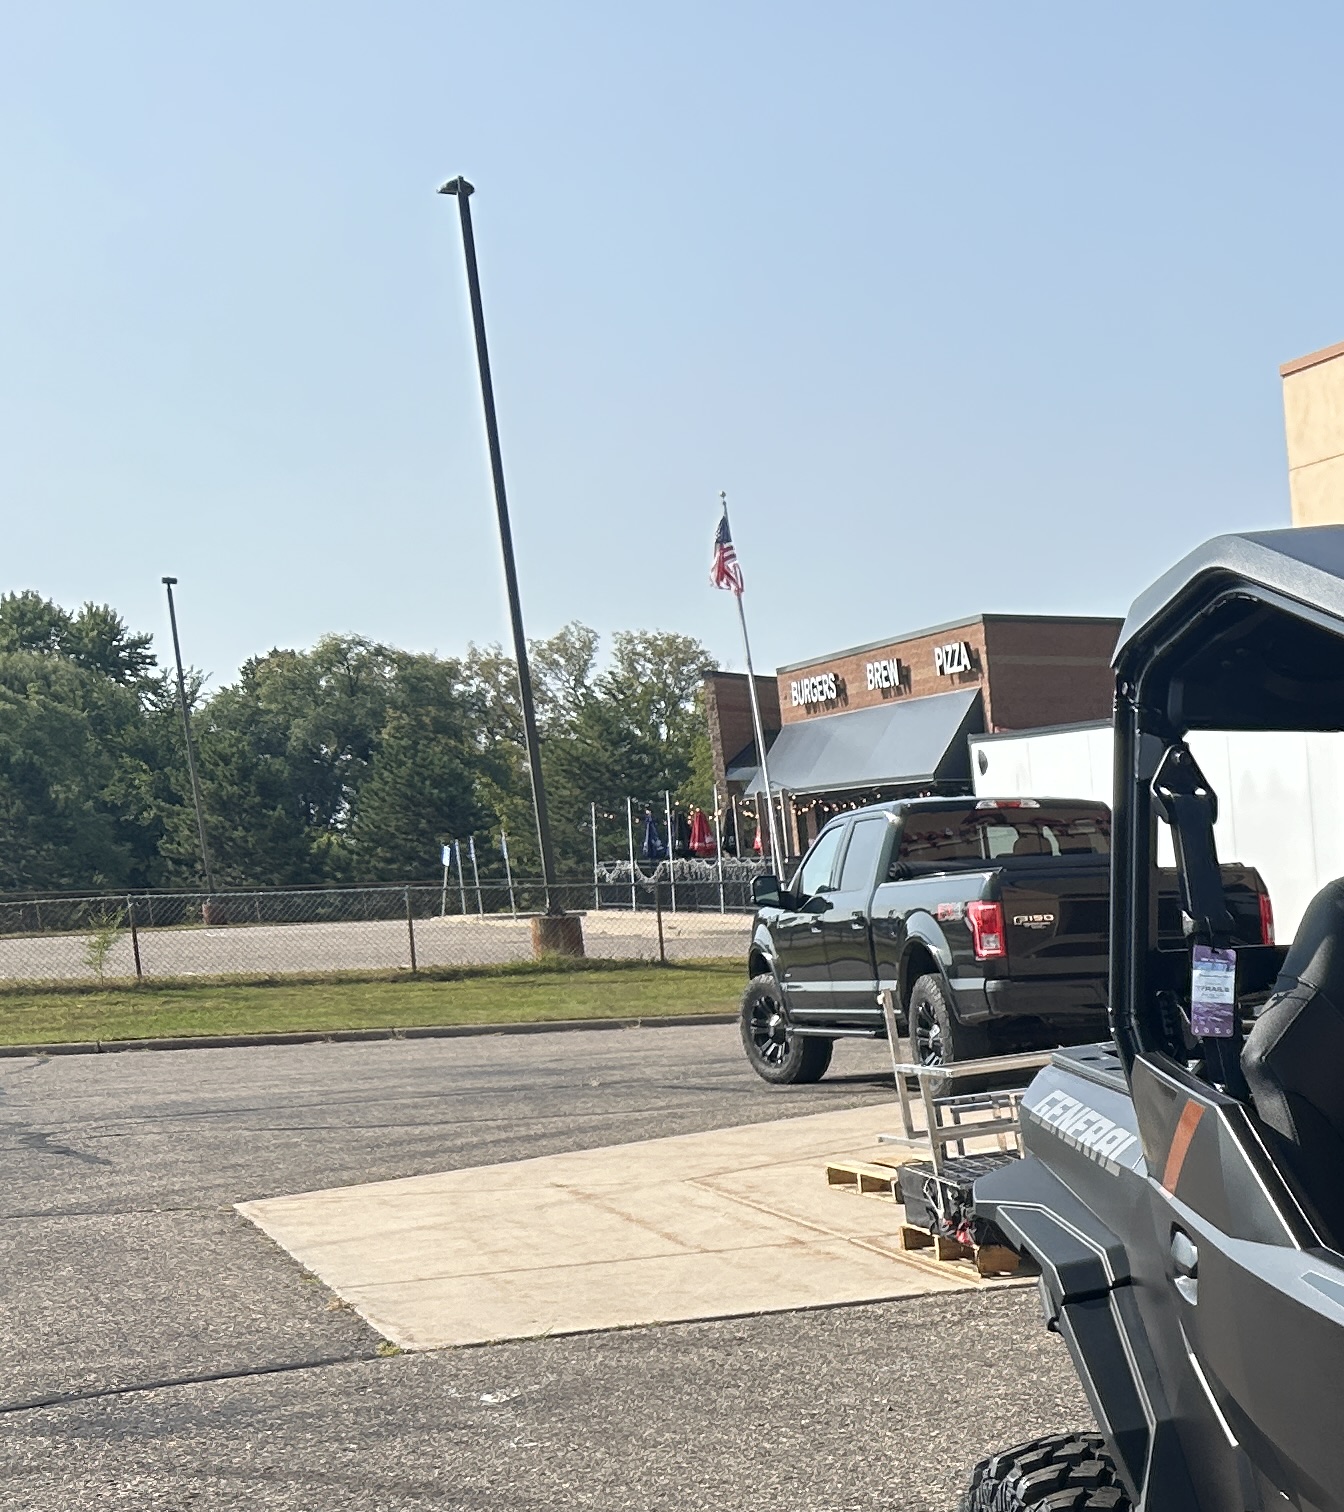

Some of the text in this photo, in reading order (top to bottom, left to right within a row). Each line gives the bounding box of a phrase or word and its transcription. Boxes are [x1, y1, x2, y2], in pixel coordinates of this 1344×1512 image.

[790, 641, 971, 707] BURGERS BREW PIZZA
[1029, 1089, 1137, 1177] GENERAL
